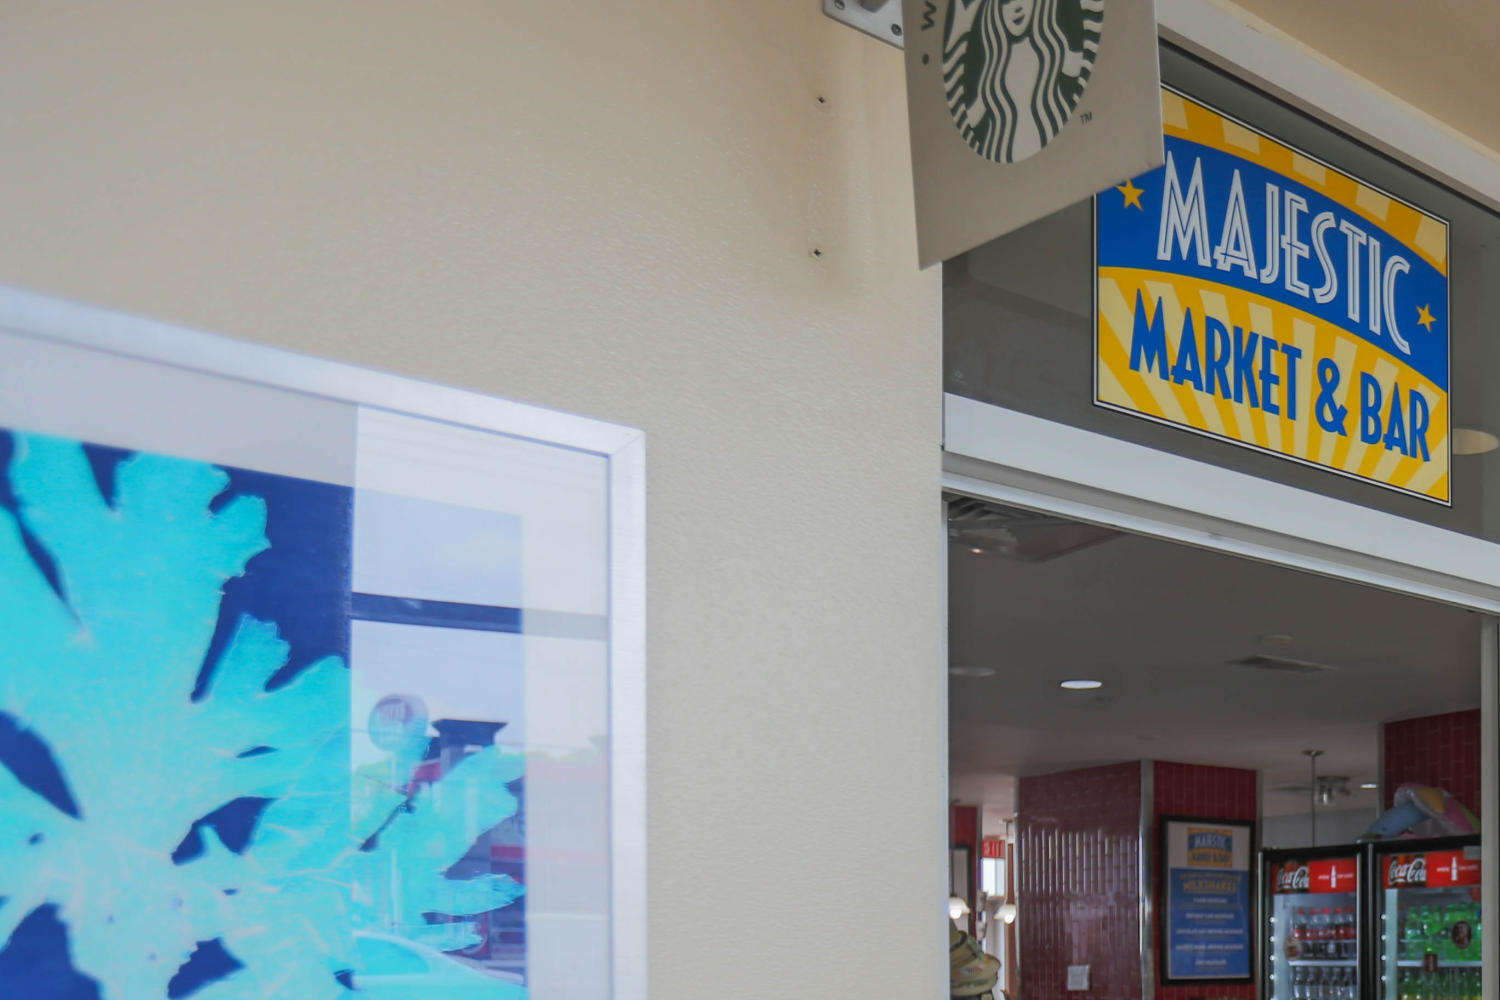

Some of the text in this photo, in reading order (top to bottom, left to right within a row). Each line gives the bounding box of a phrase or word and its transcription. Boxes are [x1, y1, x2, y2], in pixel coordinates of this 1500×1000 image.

[1157, 150, 1410, 355] MAJESTIC
[1129, 287, 1431, 463] MARKET & BAR
